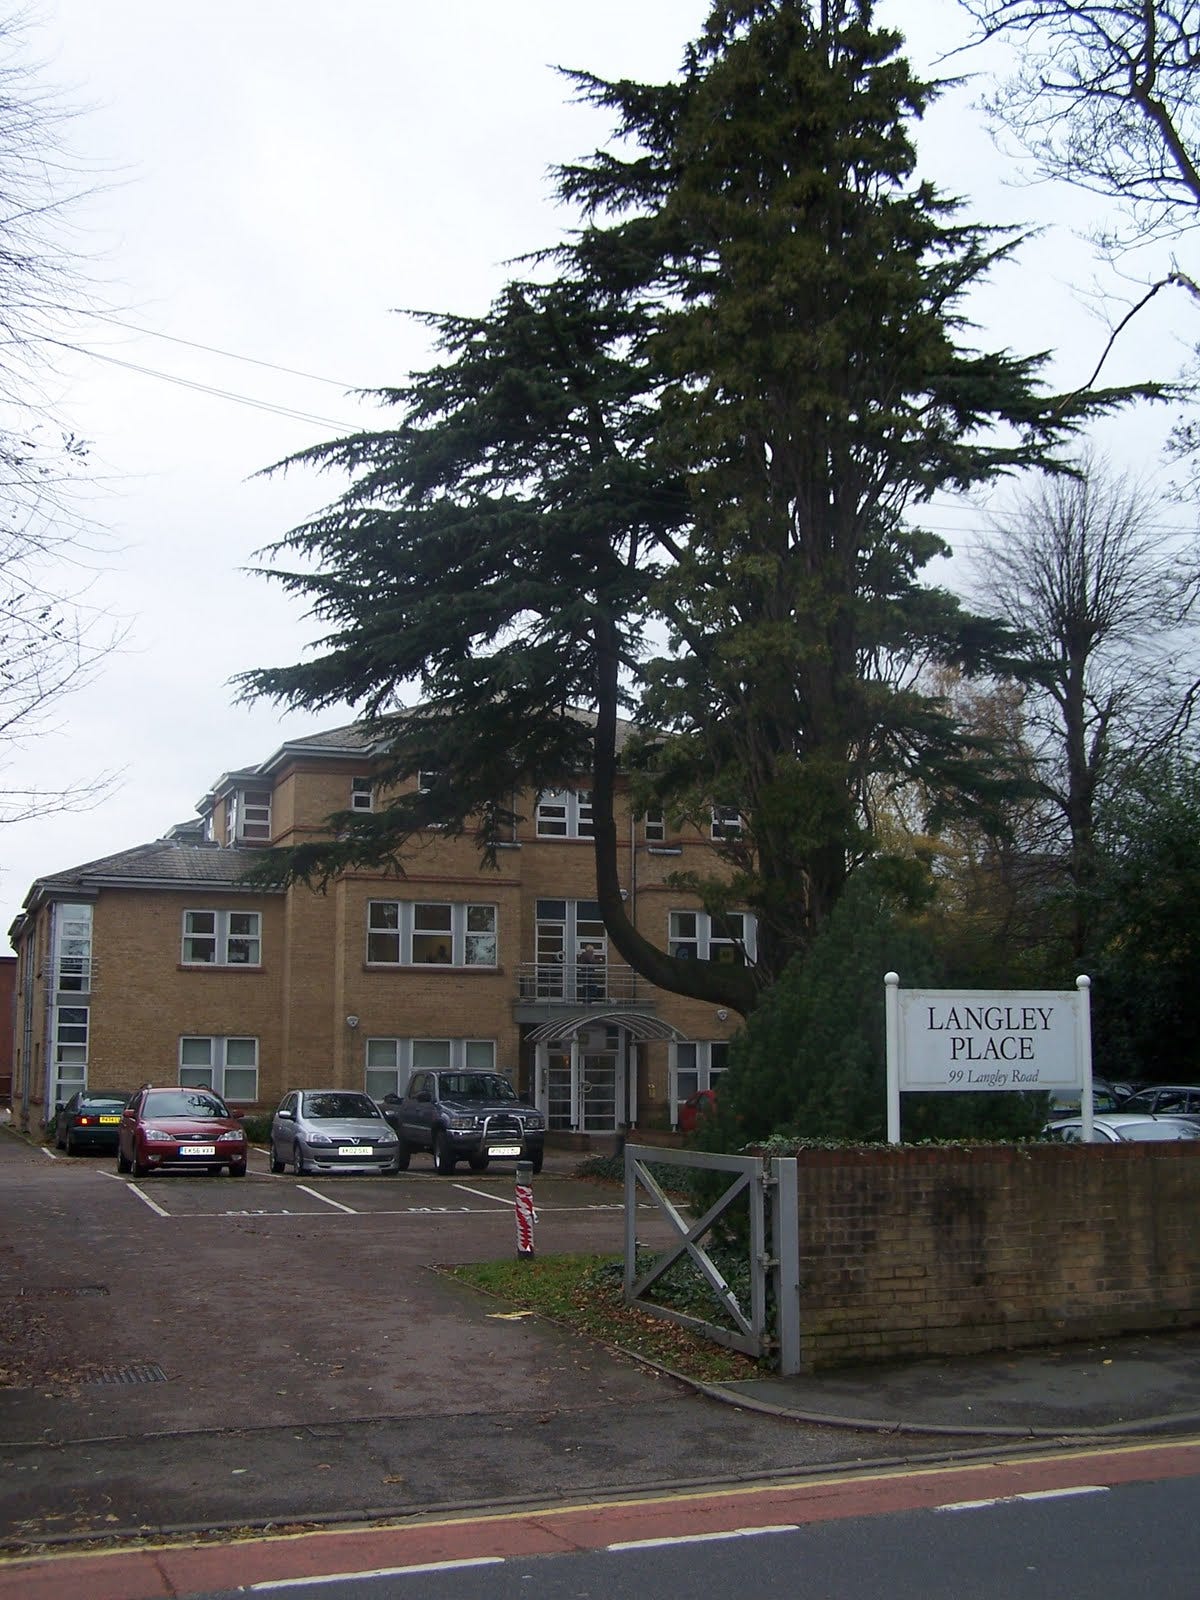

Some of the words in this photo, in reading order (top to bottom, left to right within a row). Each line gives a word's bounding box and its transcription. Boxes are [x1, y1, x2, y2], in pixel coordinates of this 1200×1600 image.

[928, 1007, 1054, 1031] LANGLEY
[951, 1036, 1035, 1061] PLACE
[948, 1070, 964, 1083] 99
[968, 1070, 1009, 1086] Langley
[1012, 1069, 1040, 1083] Road
